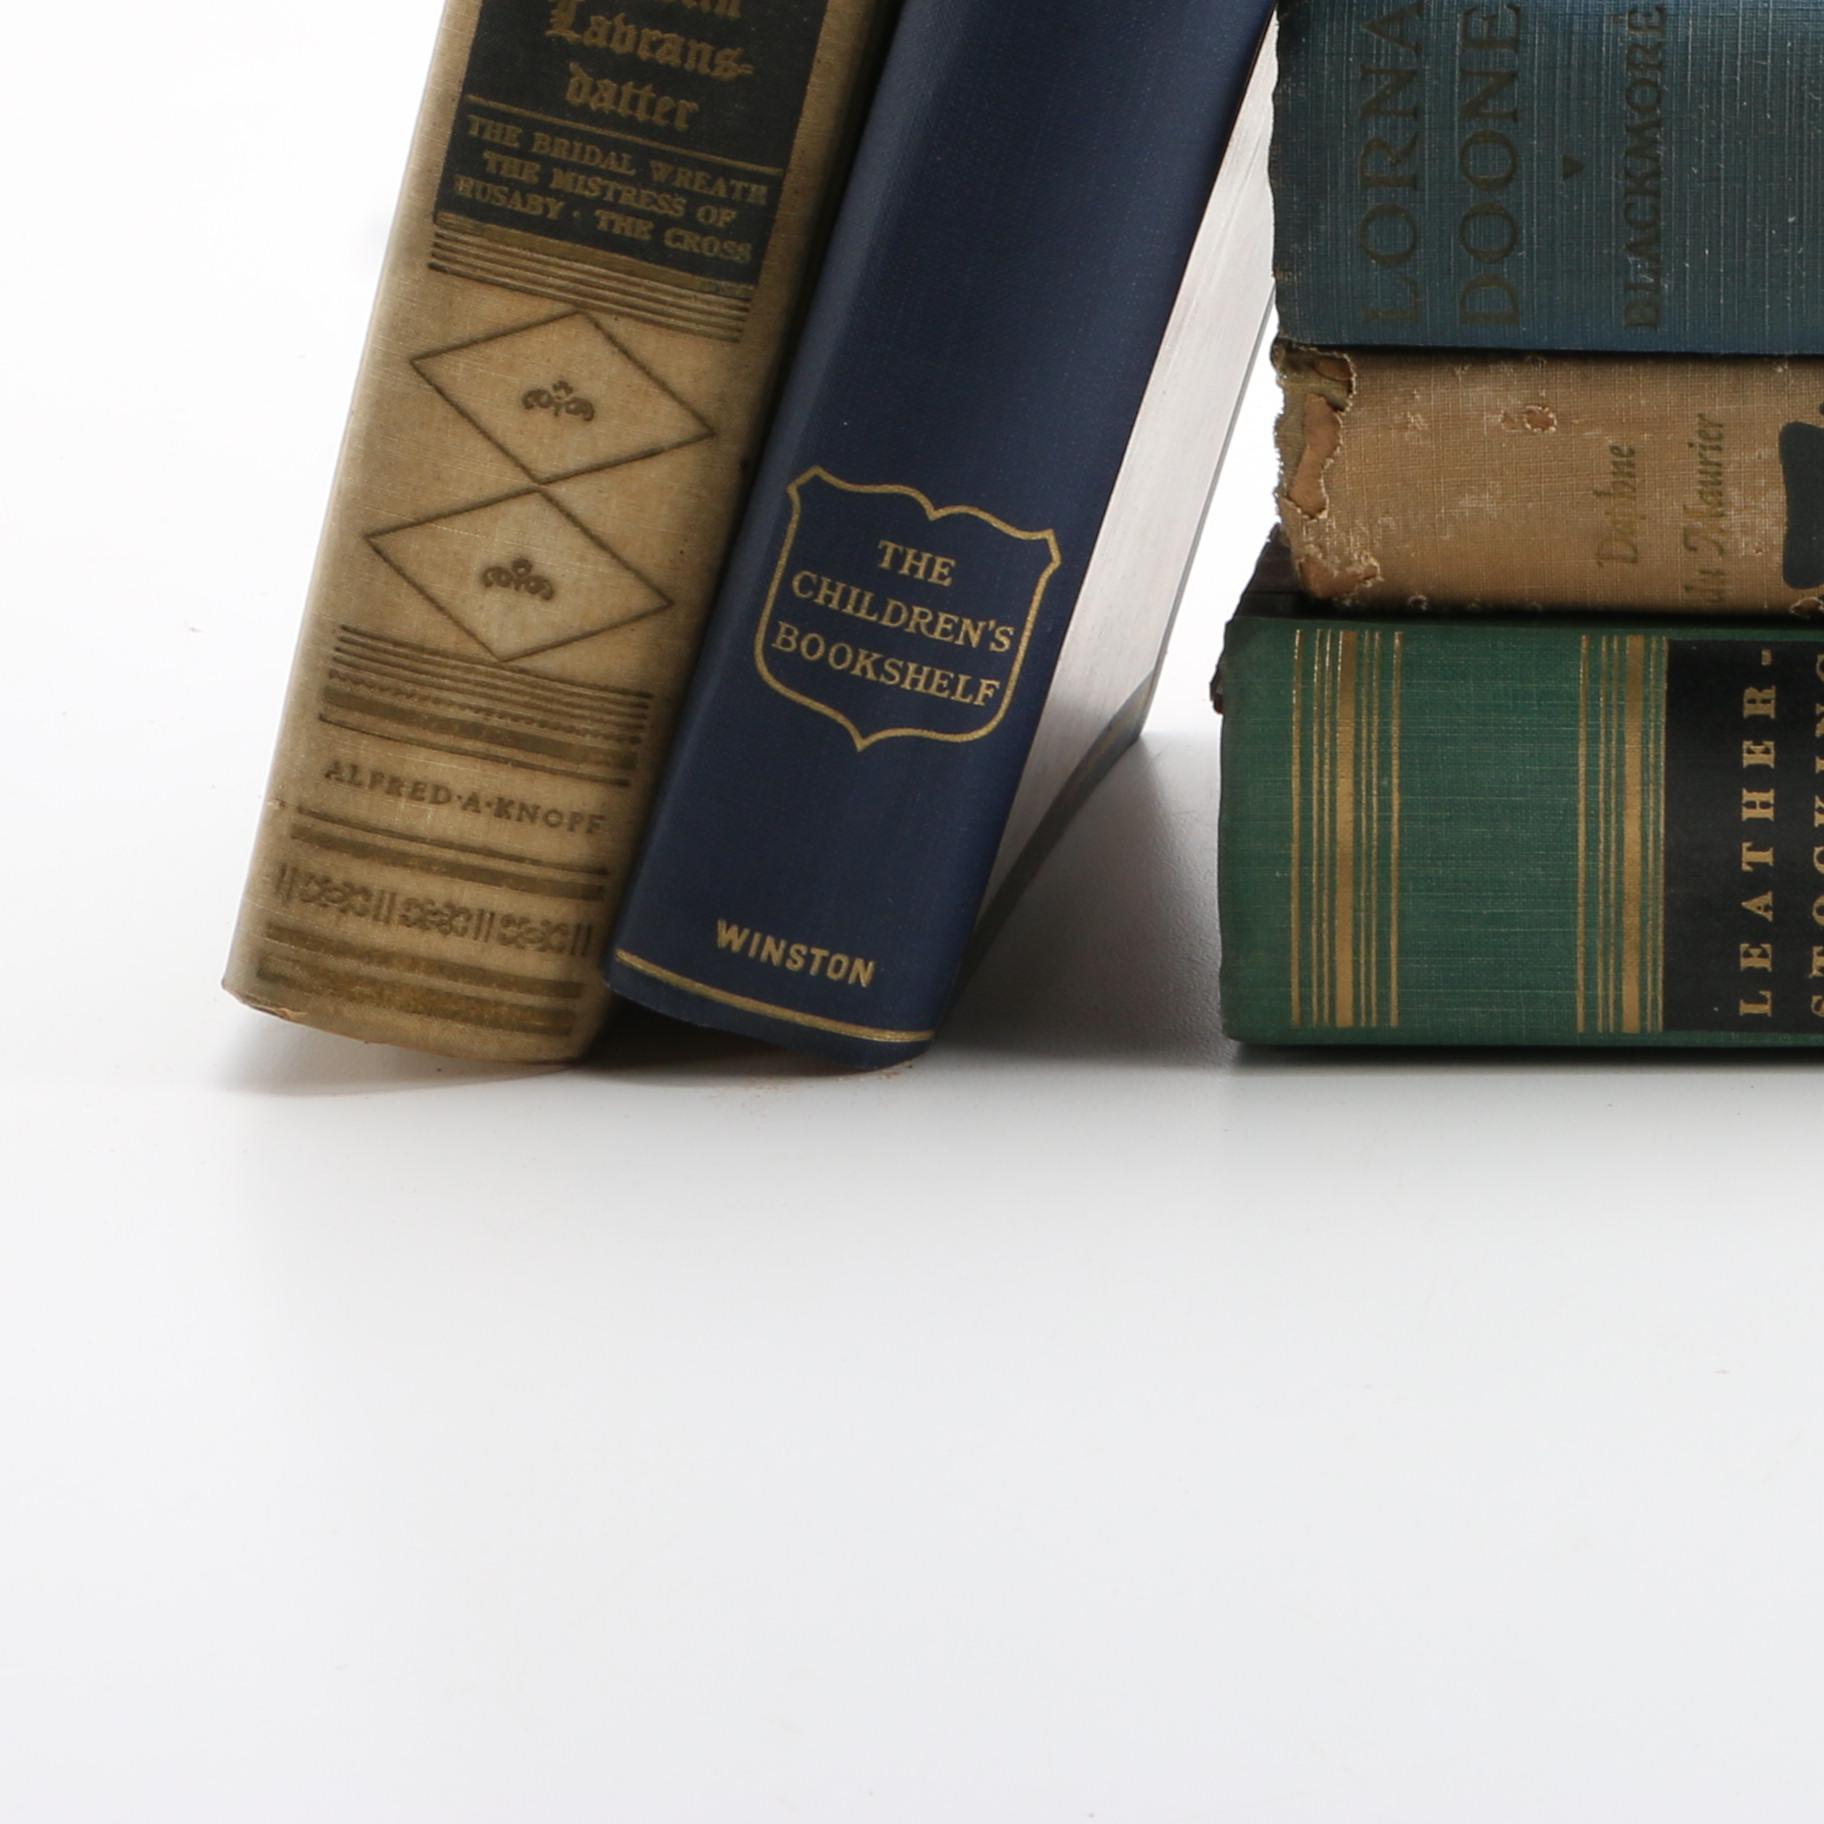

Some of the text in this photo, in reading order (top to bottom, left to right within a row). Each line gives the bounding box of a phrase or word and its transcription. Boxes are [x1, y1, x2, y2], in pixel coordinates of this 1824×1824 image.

[565, 62, 698, 132] datter
[467, 114, 769, 207] THE BRIDAL WREATH
[483, 150, 738, 229] THE MISTRESS OF
[1359, 0, 1426, 324] LORNA
[1458, 2, 1522, 327] DOONE
[1622, 3, 1666, 333] BLACKMORE
[454, 175, 753, 263] HUSABY THE CROSS
[878, 539, 956, 588] THE
[791, 569, 1015, 654] CHILDREN'S
[771, 620, 1001, 707] BOOKSHELF
[1739, 648, 1778, 1018] LEATHER-
[716, 917, 876, 989] WINSTON
